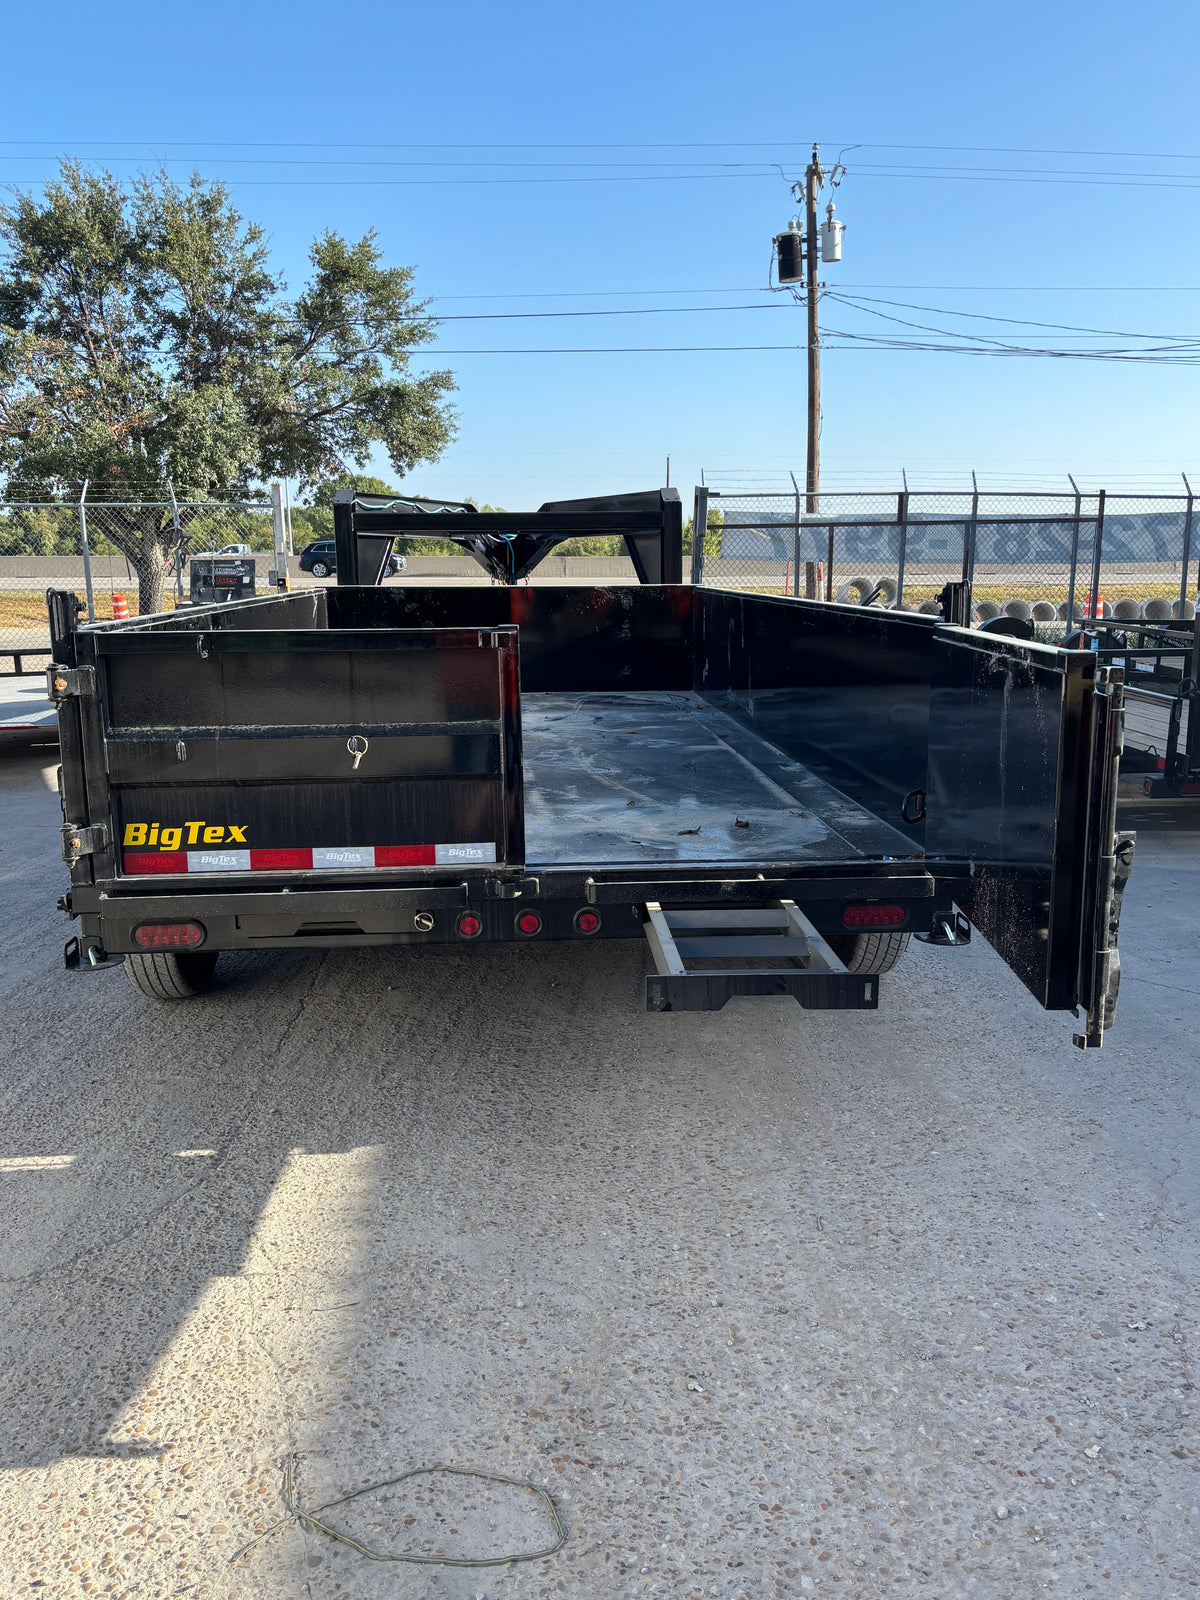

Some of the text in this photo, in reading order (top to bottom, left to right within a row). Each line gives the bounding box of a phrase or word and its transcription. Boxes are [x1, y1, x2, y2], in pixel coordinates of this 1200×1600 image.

[123, 822, 248, 851] BigTex
[326, 852, 362, 862] BigTex
[448, 848, 483, 858] BigTex
[201, 855, 238, 865] BigTex
